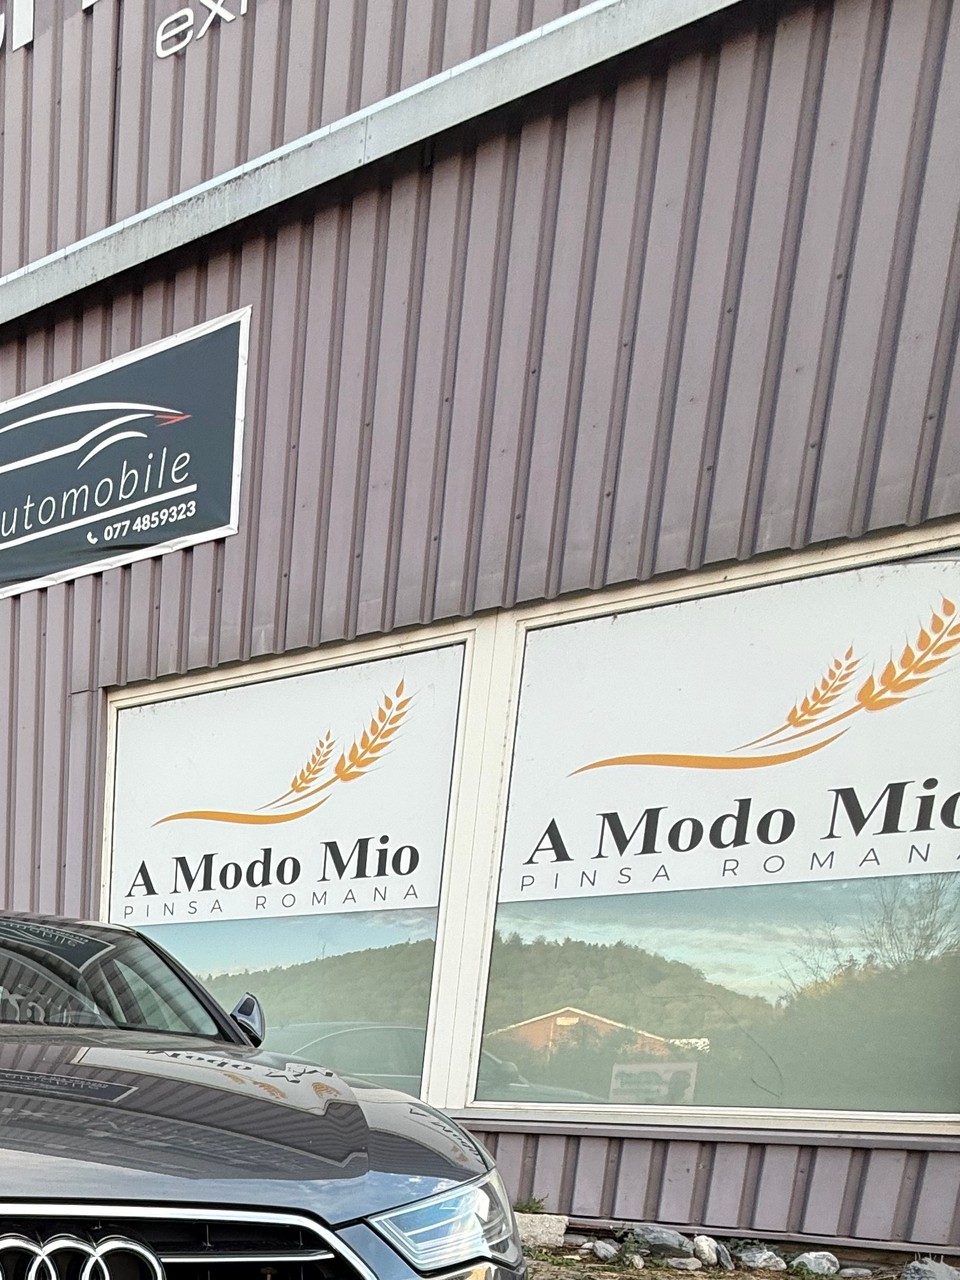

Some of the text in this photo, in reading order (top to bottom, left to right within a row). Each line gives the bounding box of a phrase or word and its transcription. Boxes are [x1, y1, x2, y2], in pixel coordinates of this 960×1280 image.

[103, 500, 197, 541] 077 4859323
[522, 817, 575, 866] A
[590, 797, 797, 860] Modo
[125, 834, 421, 898] A Modo Mio
[520, 842, 960, 892] PINSA ROMAN
[123, 884, 419, 920] PINSA ROMANA
